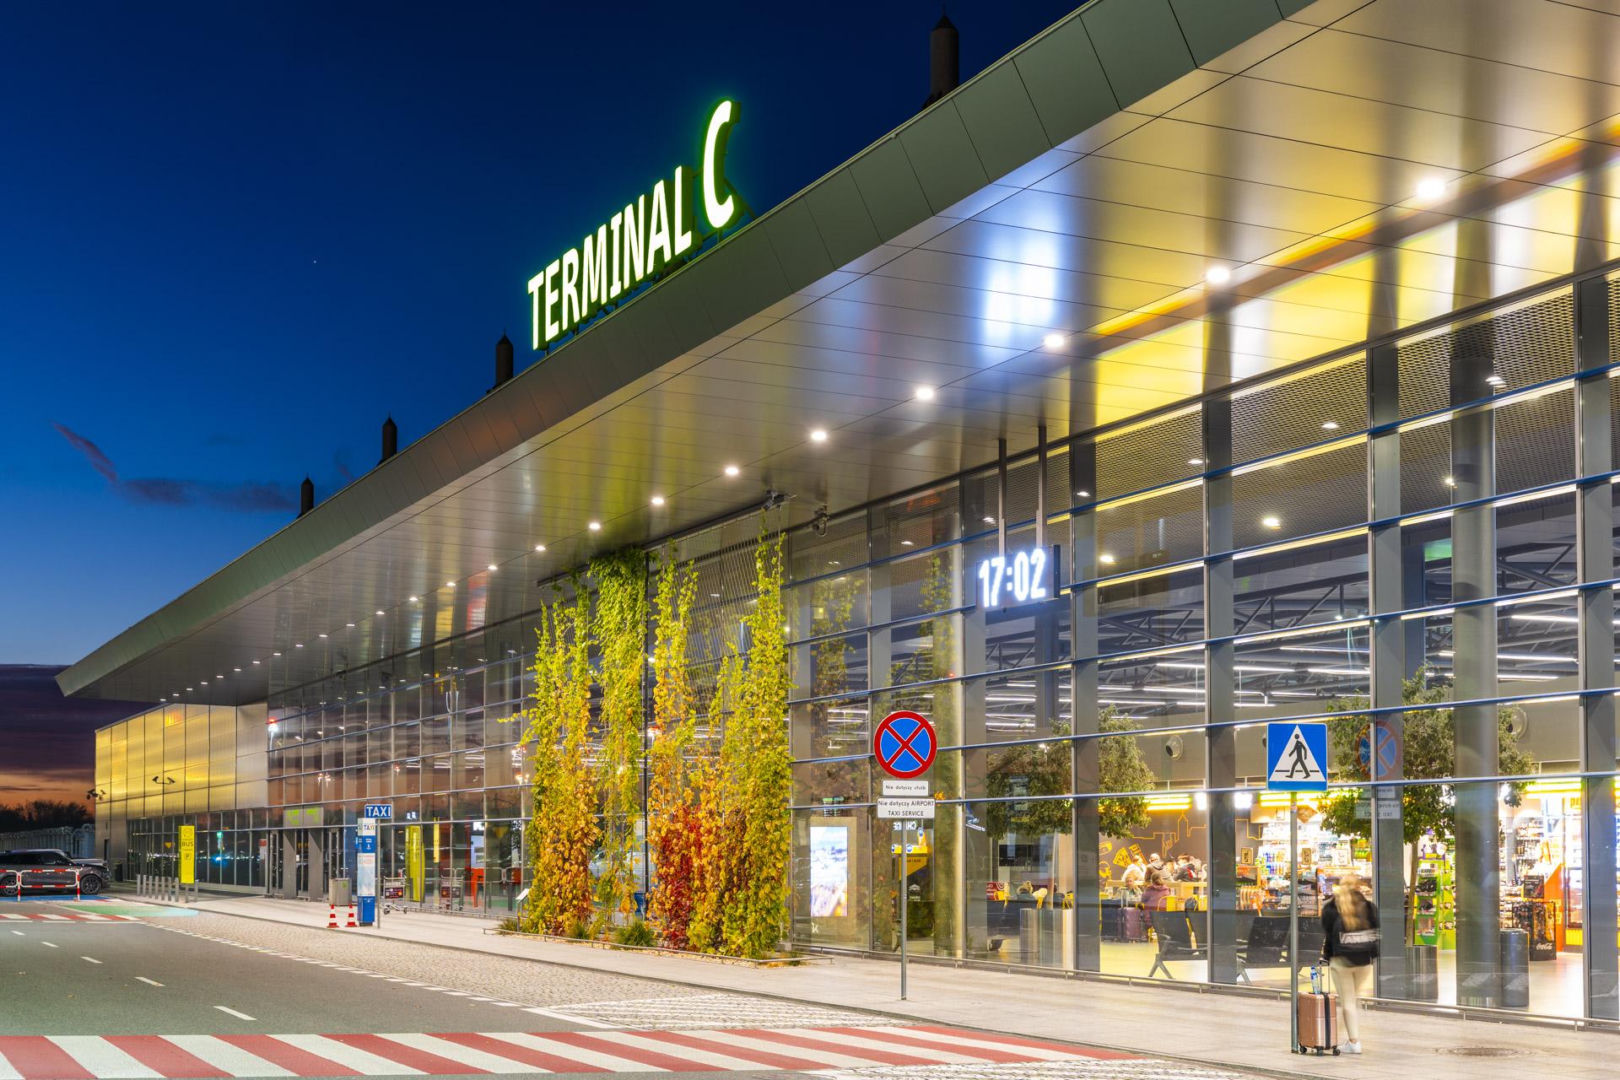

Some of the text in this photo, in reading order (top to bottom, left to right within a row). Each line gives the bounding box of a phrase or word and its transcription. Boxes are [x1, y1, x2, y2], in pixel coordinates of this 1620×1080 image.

[528, 100, 735, 350] TERMINAL C
[979, 548, 1046, 607] 17:02
[366, 806, 391, 817] TAXI
